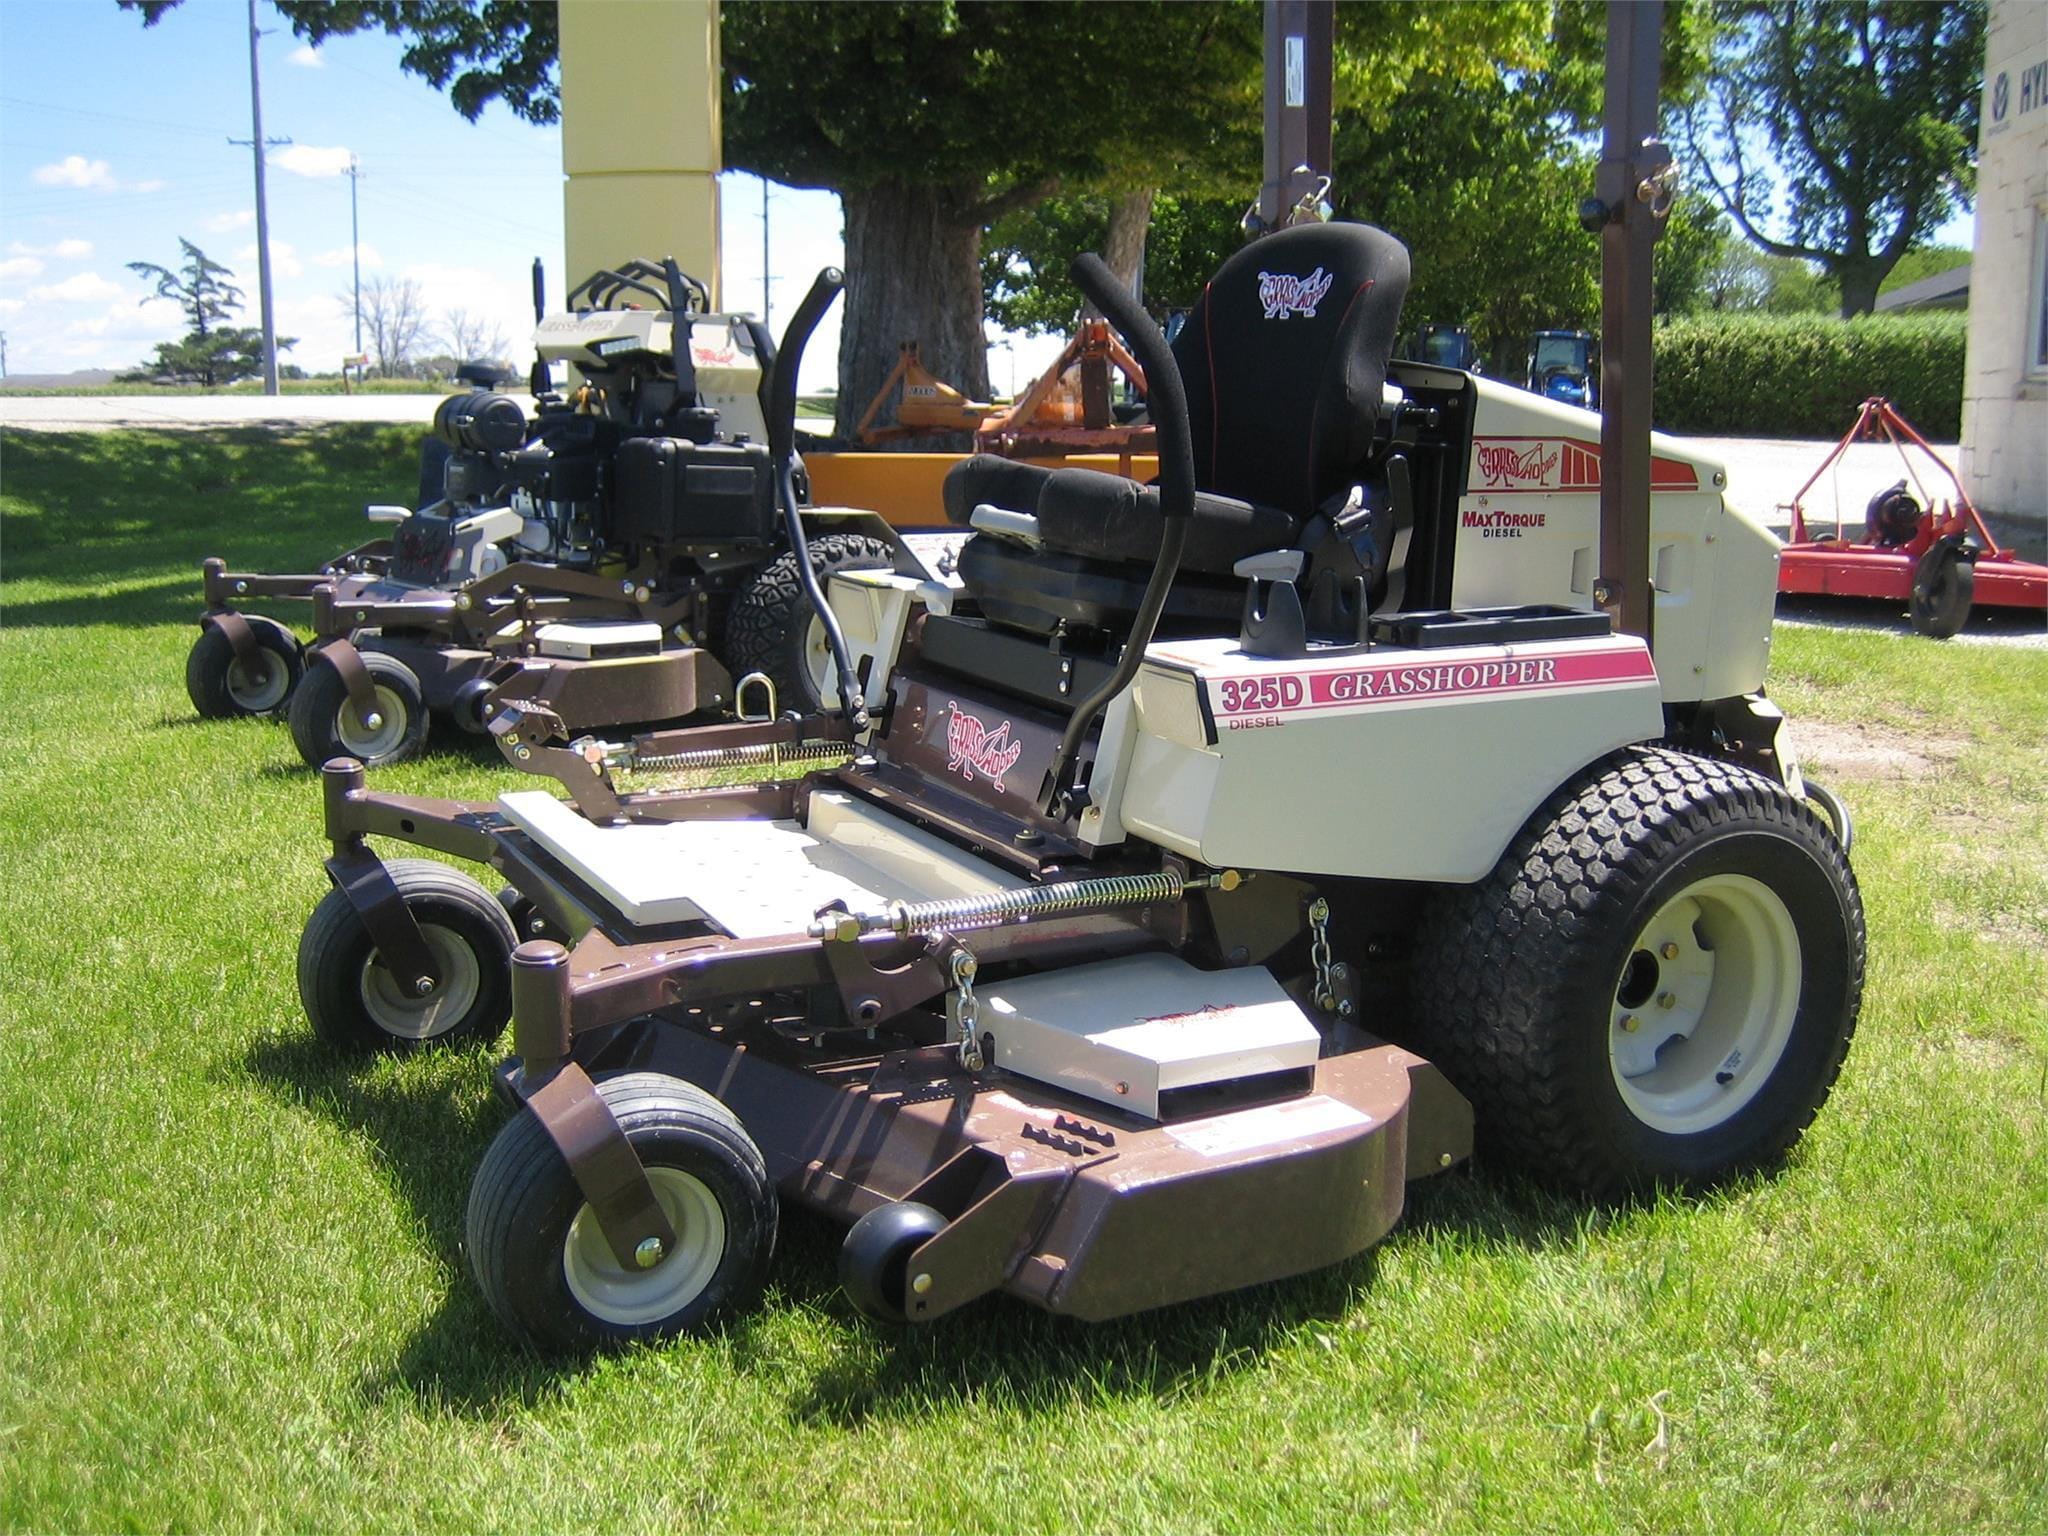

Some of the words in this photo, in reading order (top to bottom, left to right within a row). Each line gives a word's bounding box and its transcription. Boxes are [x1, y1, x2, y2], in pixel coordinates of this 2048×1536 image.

[1476, 445, 1558, 481] GRASSHOPPER
[1482, 527, 1523, 539] DIESEL
[1220, 675, 1304, 713] 325D
[1328, 658, 1557, 701] GRASSHOPPER
[1228, 715, 1285, 731] DIESEL
